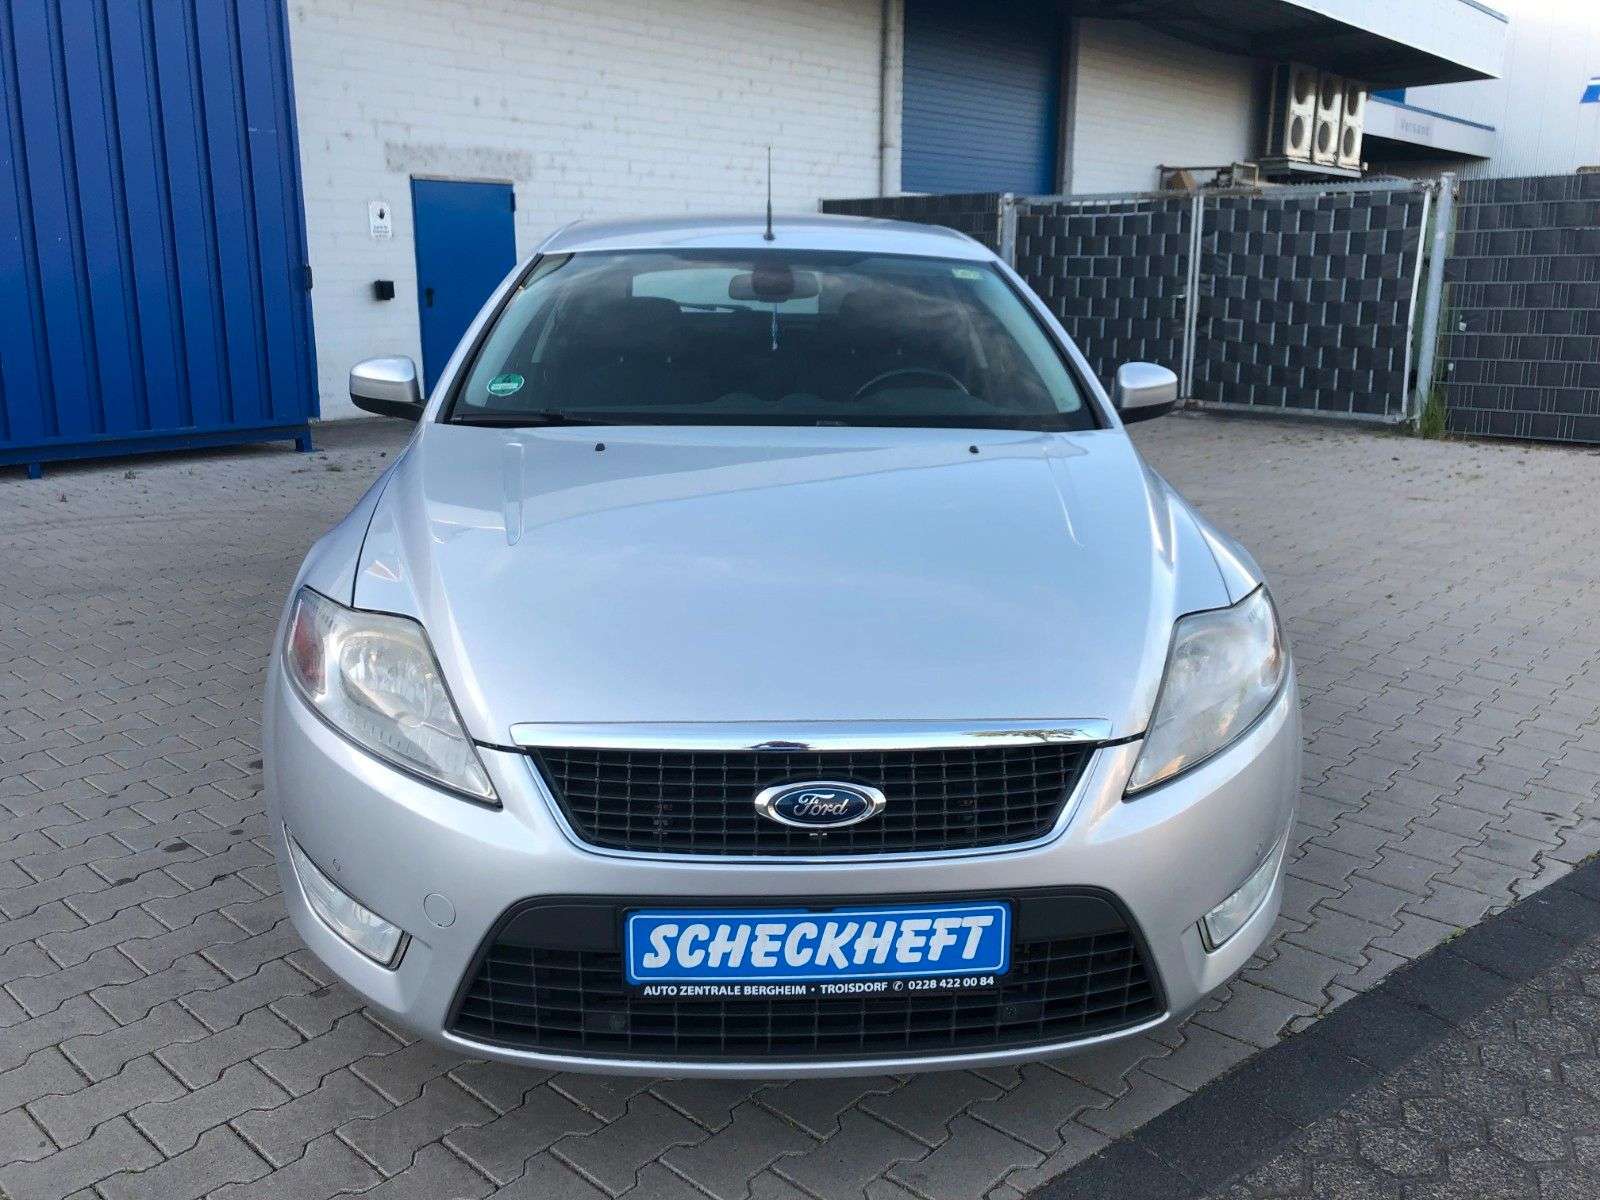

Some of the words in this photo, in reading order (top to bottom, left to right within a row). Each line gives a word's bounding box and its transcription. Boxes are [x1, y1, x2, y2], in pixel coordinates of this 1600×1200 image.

[793, 793, 850, 817] Ford
[642, 915, 994, 969] SCHECKHEFT
[643, 985, 678, 996] AUTO
[680, 985, 741, 996] ZENTRALE
[744, 985, 807, 995] BERGHEIM
[820, 982, 889, 994] TROISDORF
[908, 979, 937, 990] 0228
[939, 978, 961, 989] 422
[963, 977, 978, 987] 00
[979, 976, 995, 986] 84
